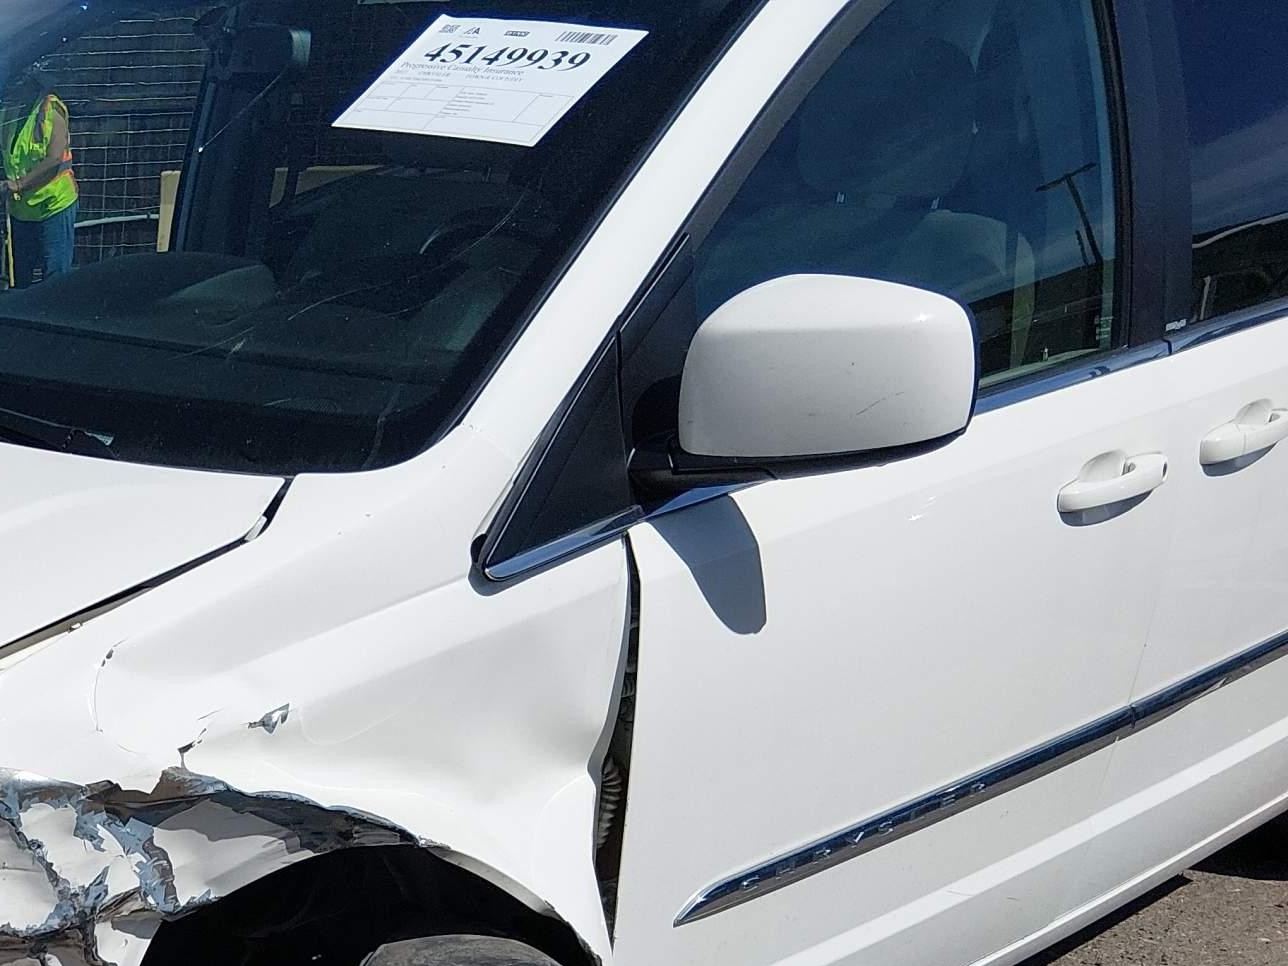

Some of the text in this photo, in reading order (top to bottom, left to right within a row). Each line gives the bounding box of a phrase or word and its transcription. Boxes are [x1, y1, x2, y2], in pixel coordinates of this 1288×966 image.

[400, 61, 525, 76] Progressive Casualty Insurance
[423, 43, 591, 72] 45149939
